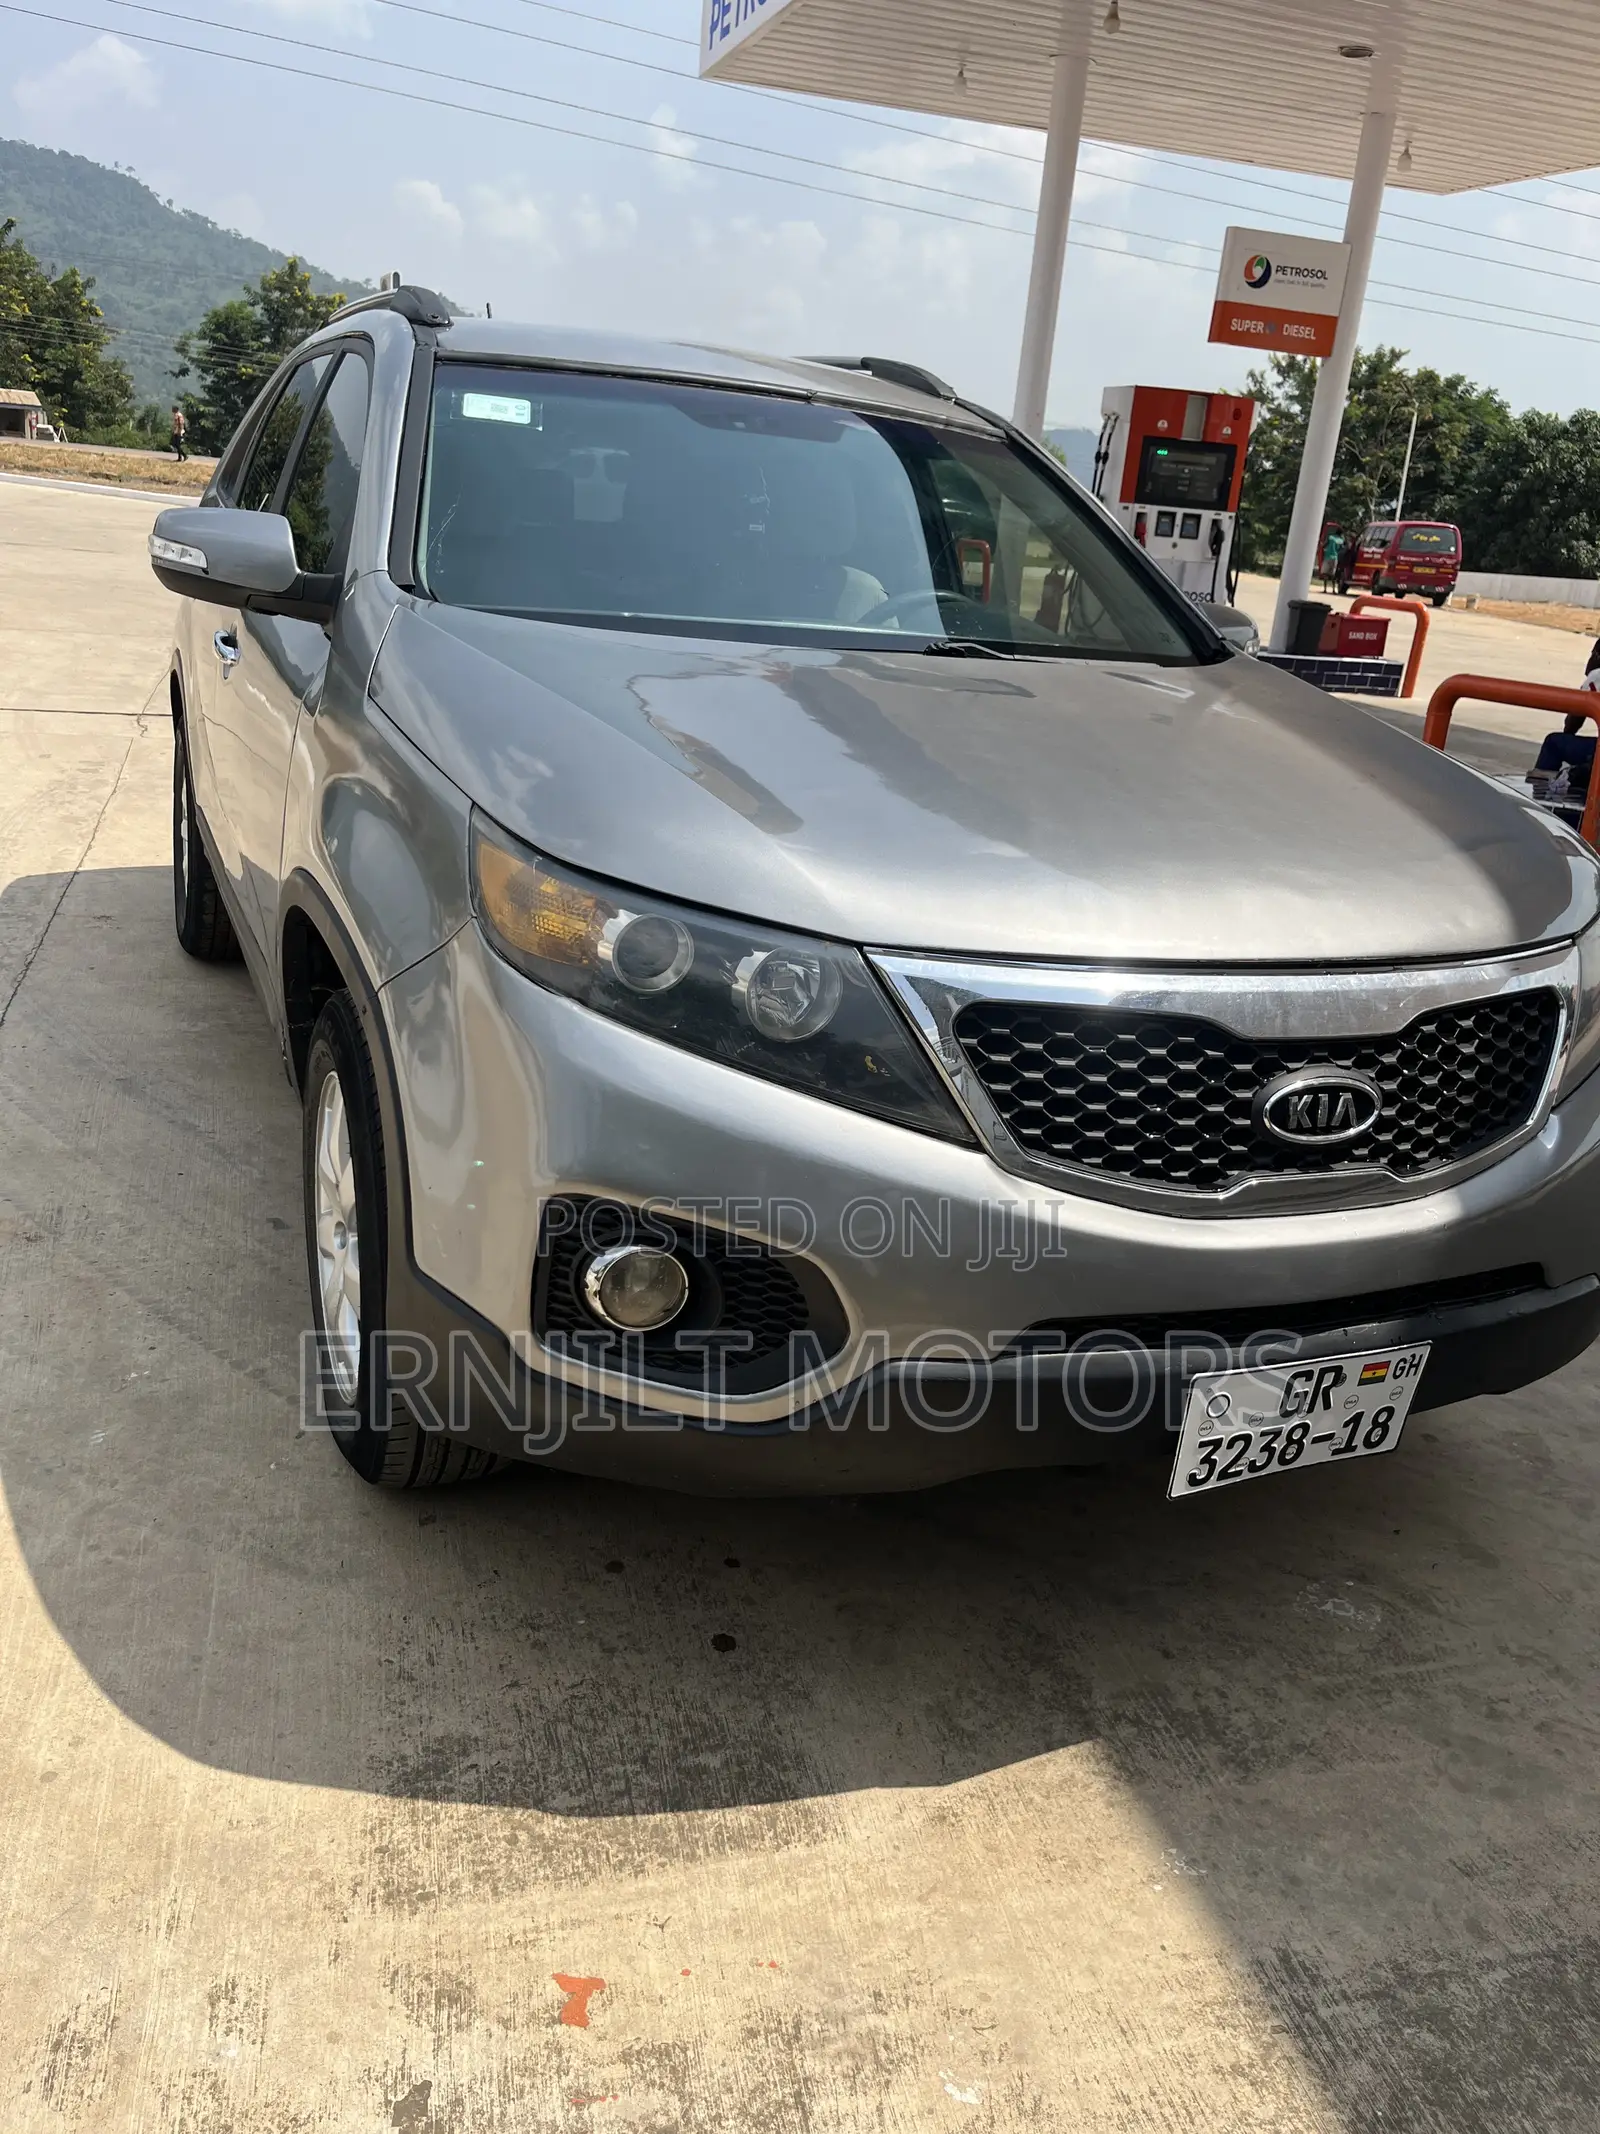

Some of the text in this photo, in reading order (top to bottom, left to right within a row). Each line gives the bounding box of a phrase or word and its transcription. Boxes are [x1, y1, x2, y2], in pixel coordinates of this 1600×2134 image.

[1275, 265, 1328, 280] PETROSOL
[1230, 318, 1317, 340] SUPER DIESEL
[1348, 631, 1378, 641] SAND BOX
[1288, 1092, 1357, 1130] KIA
[1392, 1353, 1423, 1380] GH
[1279, 1364, 1344, 1418] GR
[1186, 1405, 1396, 1488] 3238-18
